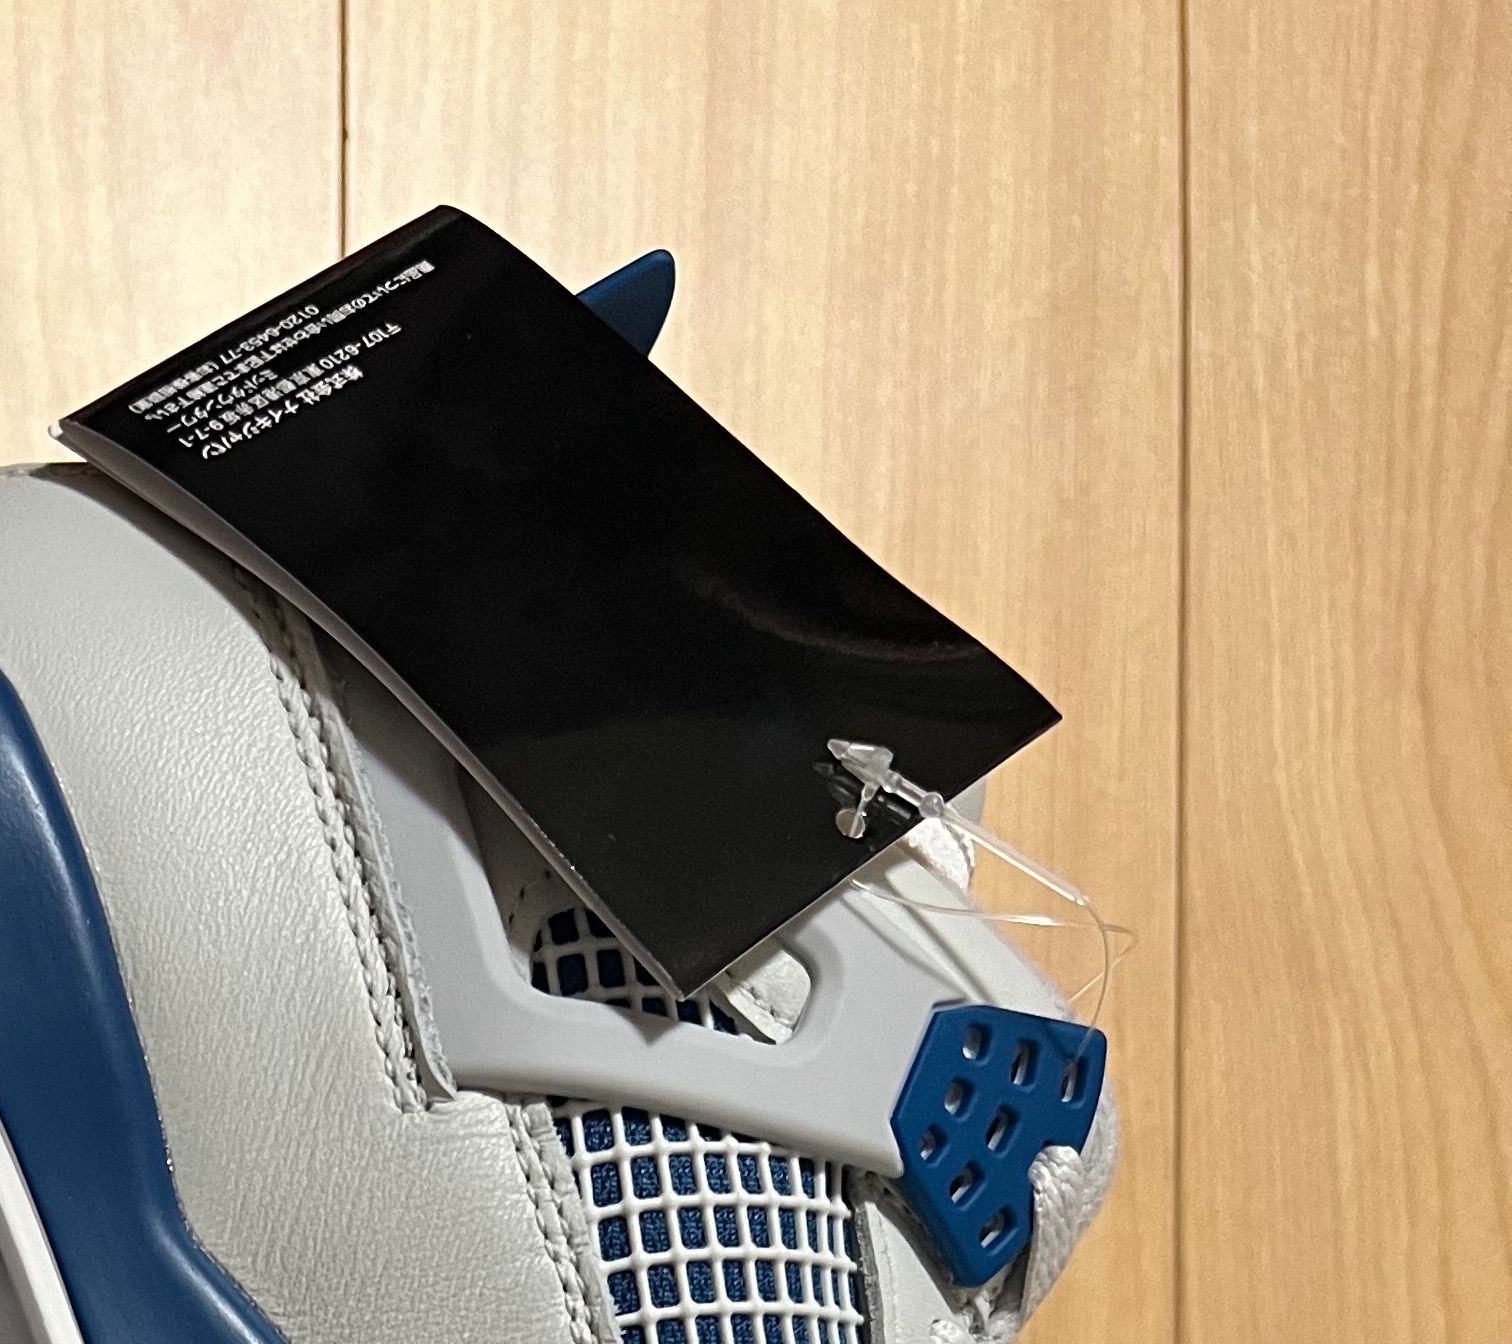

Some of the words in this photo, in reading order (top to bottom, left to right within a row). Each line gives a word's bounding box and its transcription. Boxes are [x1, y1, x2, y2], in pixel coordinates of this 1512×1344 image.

[201, 399, 300, 460] ナイキジャパン
